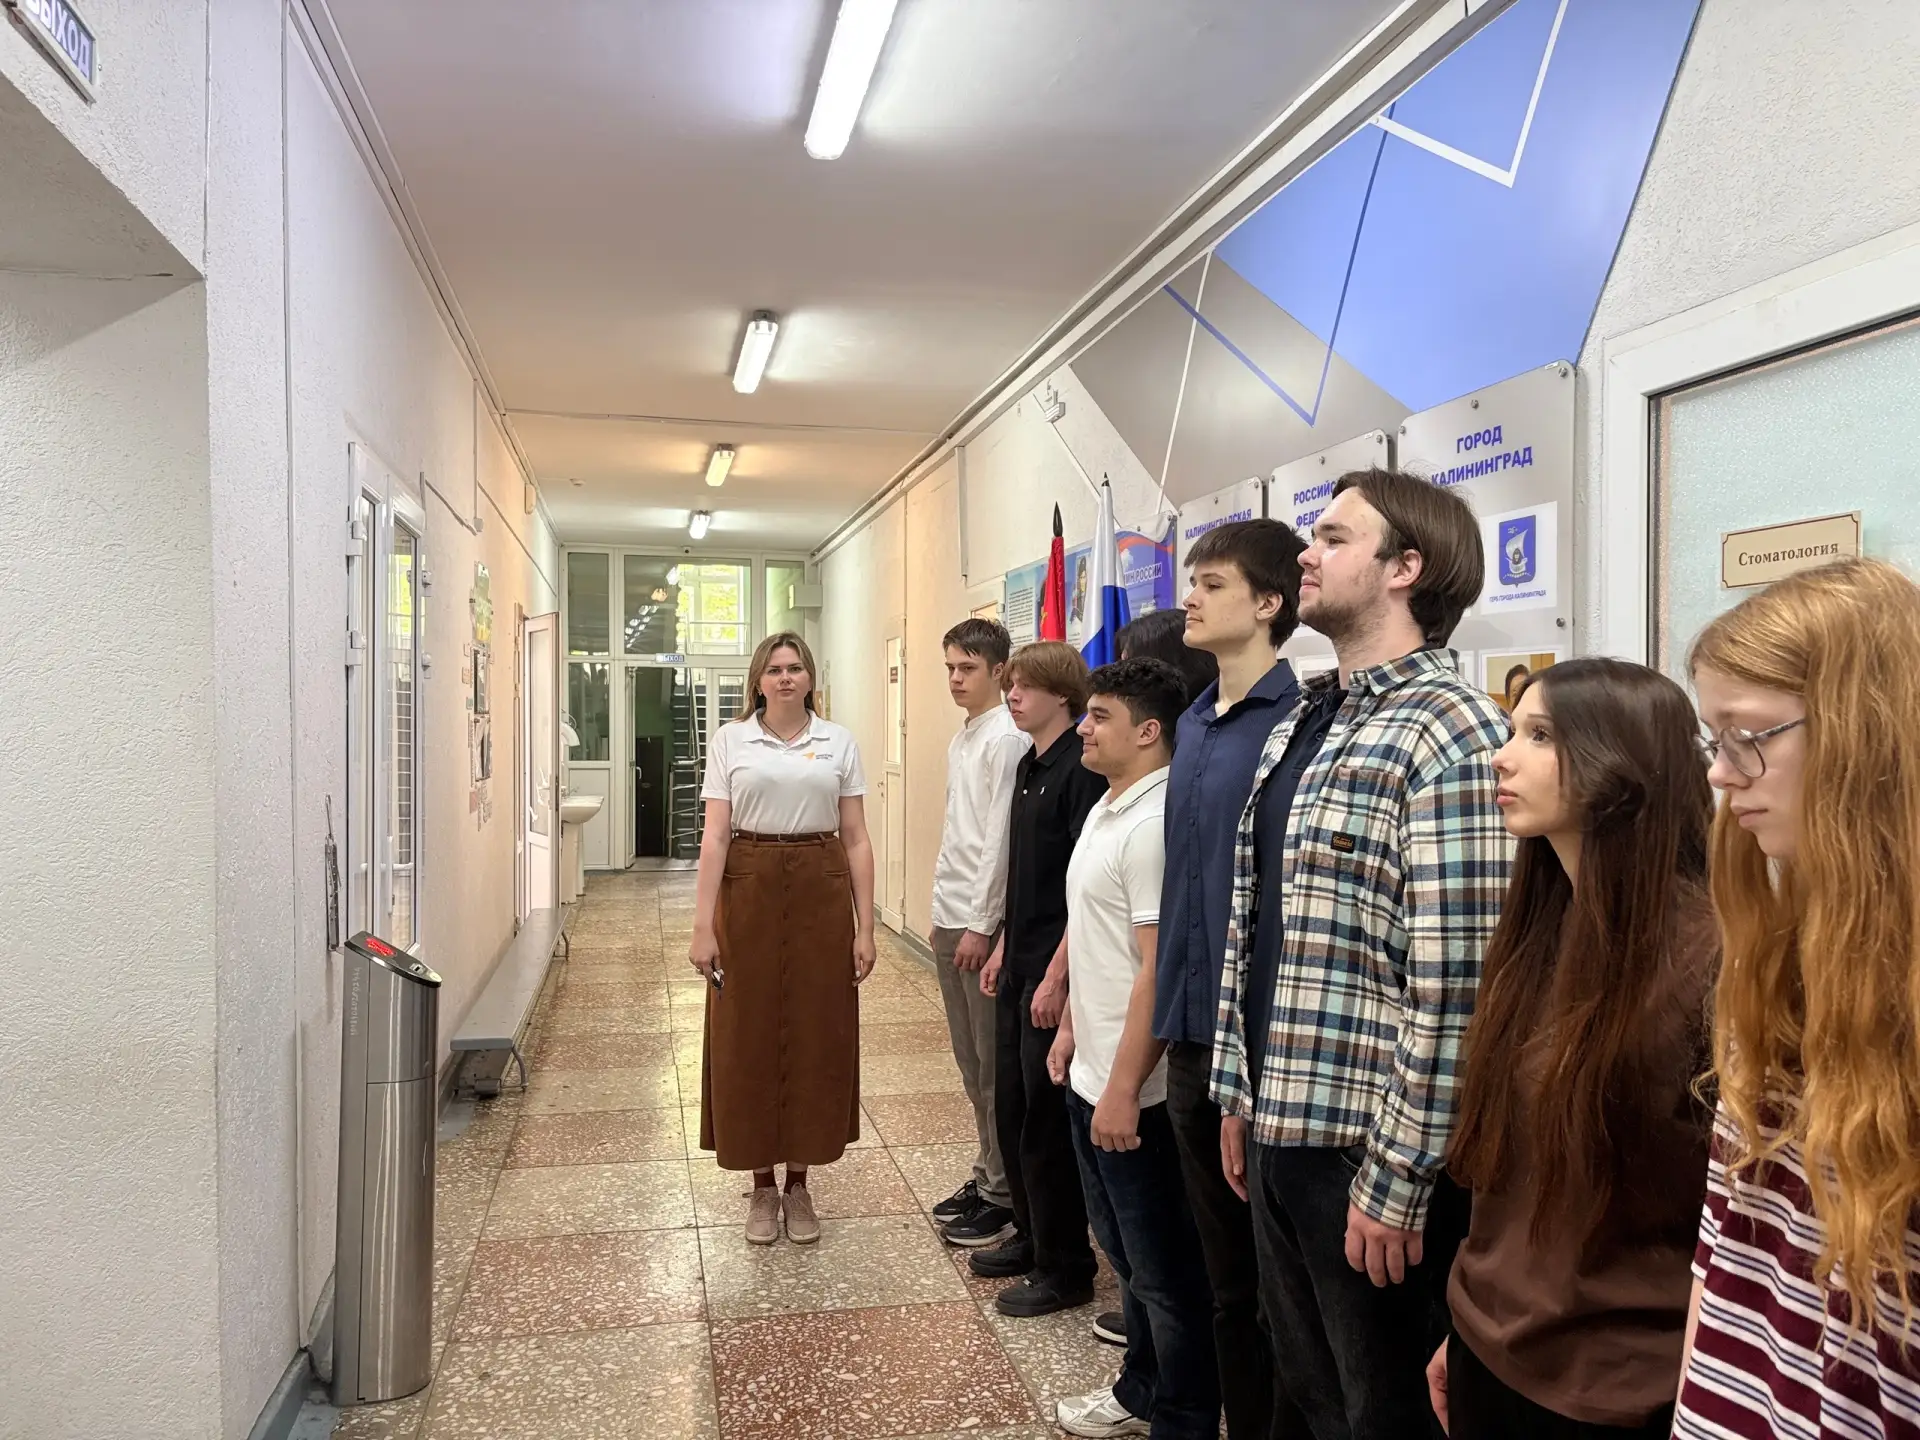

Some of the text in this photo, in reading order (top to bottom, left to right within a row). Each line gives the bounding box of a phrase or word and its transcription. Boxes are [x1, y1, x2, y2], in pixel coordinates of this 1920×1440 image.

[1456, 425, 1503, 454] ГОРОД
[1431, 446, 1533, 486] КАЛИНИНГРАД
[1293, 480, 1336, 506] РОССИЙС
[1296, 507, 1325, 528] ФЕДЕ
[1738, 543, 1839, 567] Стоматология
[1135, 562, 1162, 582] РОССИИ
